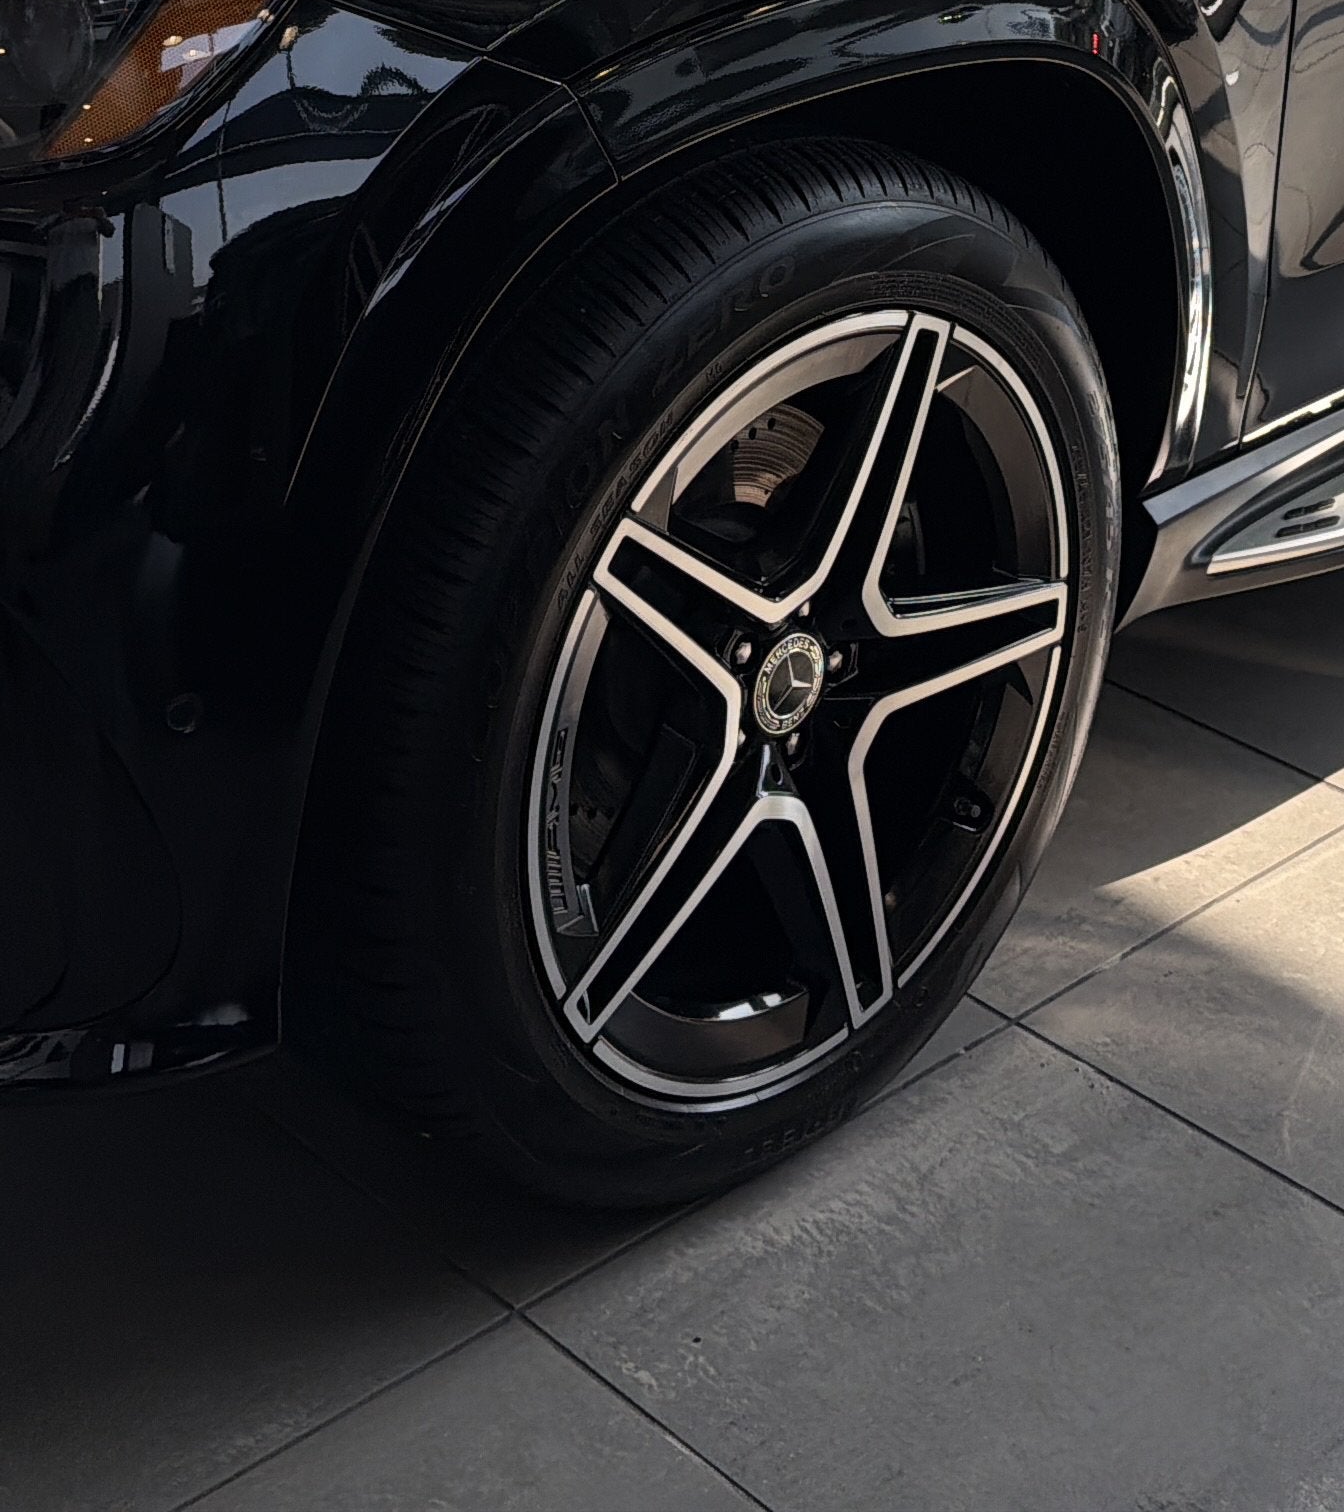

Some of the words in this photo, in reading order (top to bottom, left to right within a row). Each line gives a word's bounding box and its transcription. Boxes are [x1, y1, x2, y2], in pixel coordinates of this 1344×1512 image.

[555, 551, 586, 611] ALL
[588, 407, 674, 538] SEASON
[763, 637, 811, 675] MERCEDES
[781, 706, 806, 730] BENZ
